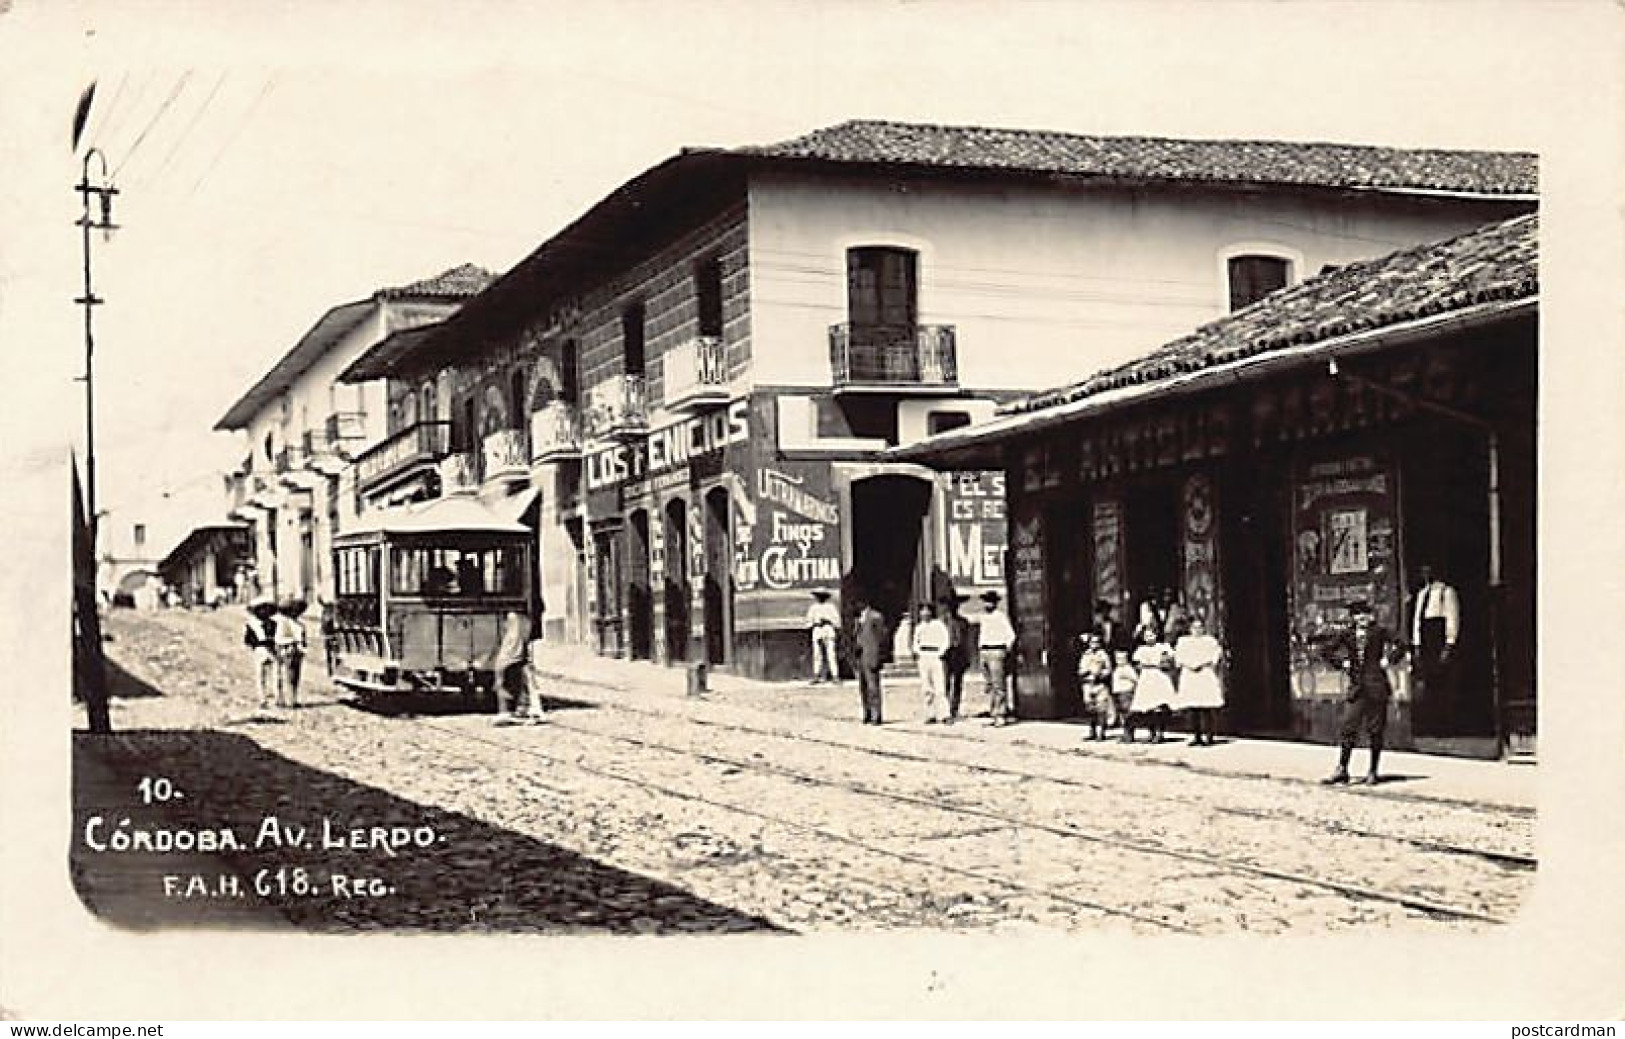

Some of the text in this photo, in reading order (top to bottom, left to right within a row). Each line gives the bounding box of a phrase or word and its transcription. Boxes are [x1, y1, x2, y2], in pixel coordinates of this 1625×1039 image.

[587, 447, 629, 488] LOS
[633, 400, 749, 476] FENICIOS
[772, 510, 824, 544] FINOS
[762, 546, 841, 589] CANTINA
